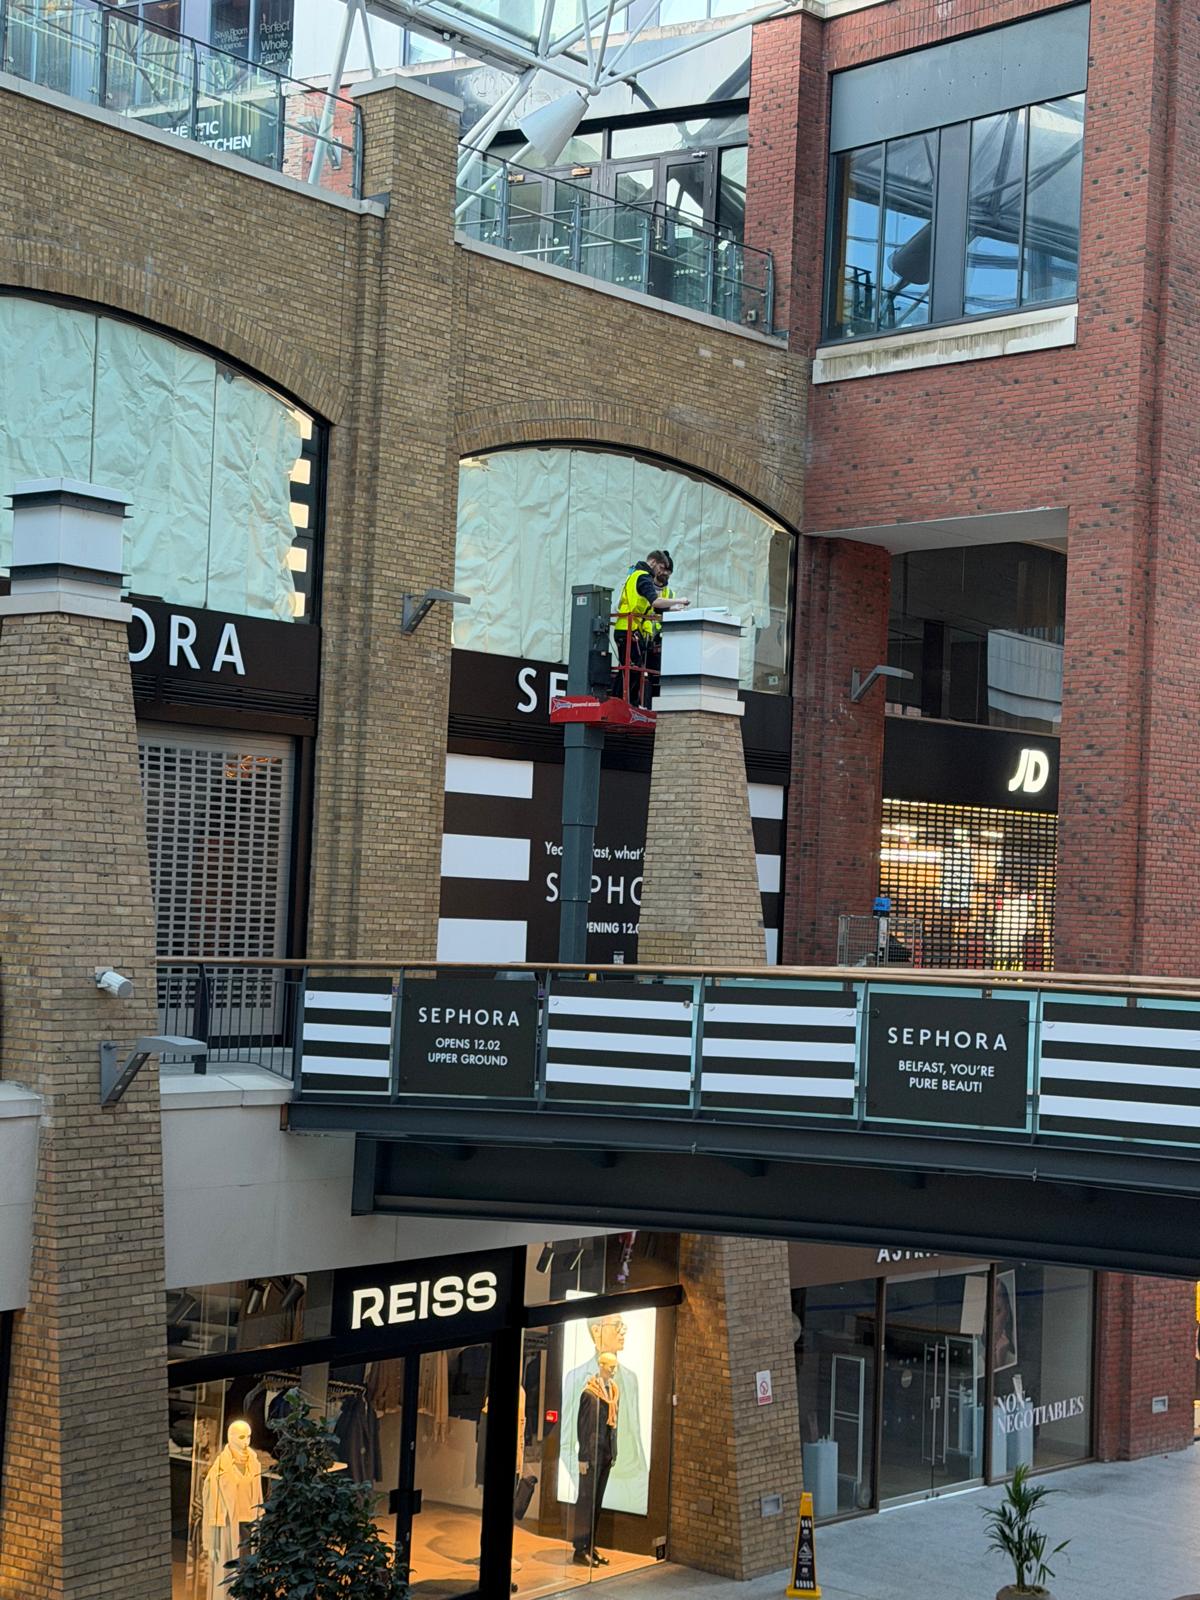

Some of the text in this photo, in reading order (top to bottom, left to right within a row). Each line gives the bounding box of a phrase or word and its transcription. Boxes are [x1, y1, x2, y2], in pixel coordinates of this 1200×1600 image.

[260, 21, 289, 34] Perfect
[1008, 748, 1049, 793] JD
[418, 1007, 520, 1027] SEPHORA
[435, 1037, 501, 1051] OPENS 12.02
[887, 1027, 1007, 1051] SEPHORA
[428, 1052, 508, 1066] UPPER GROUND
[898, 1060, 995, 1077] BELFAST, YOU'RE
[909, 1077, 983, 1093] PURE BEAUT!
[351, 1271, 498, 1330] REISS
[994, 1390, 1032, 1414] NON-
[996, 1395, 1085, 1434] NEGOTIABLES
